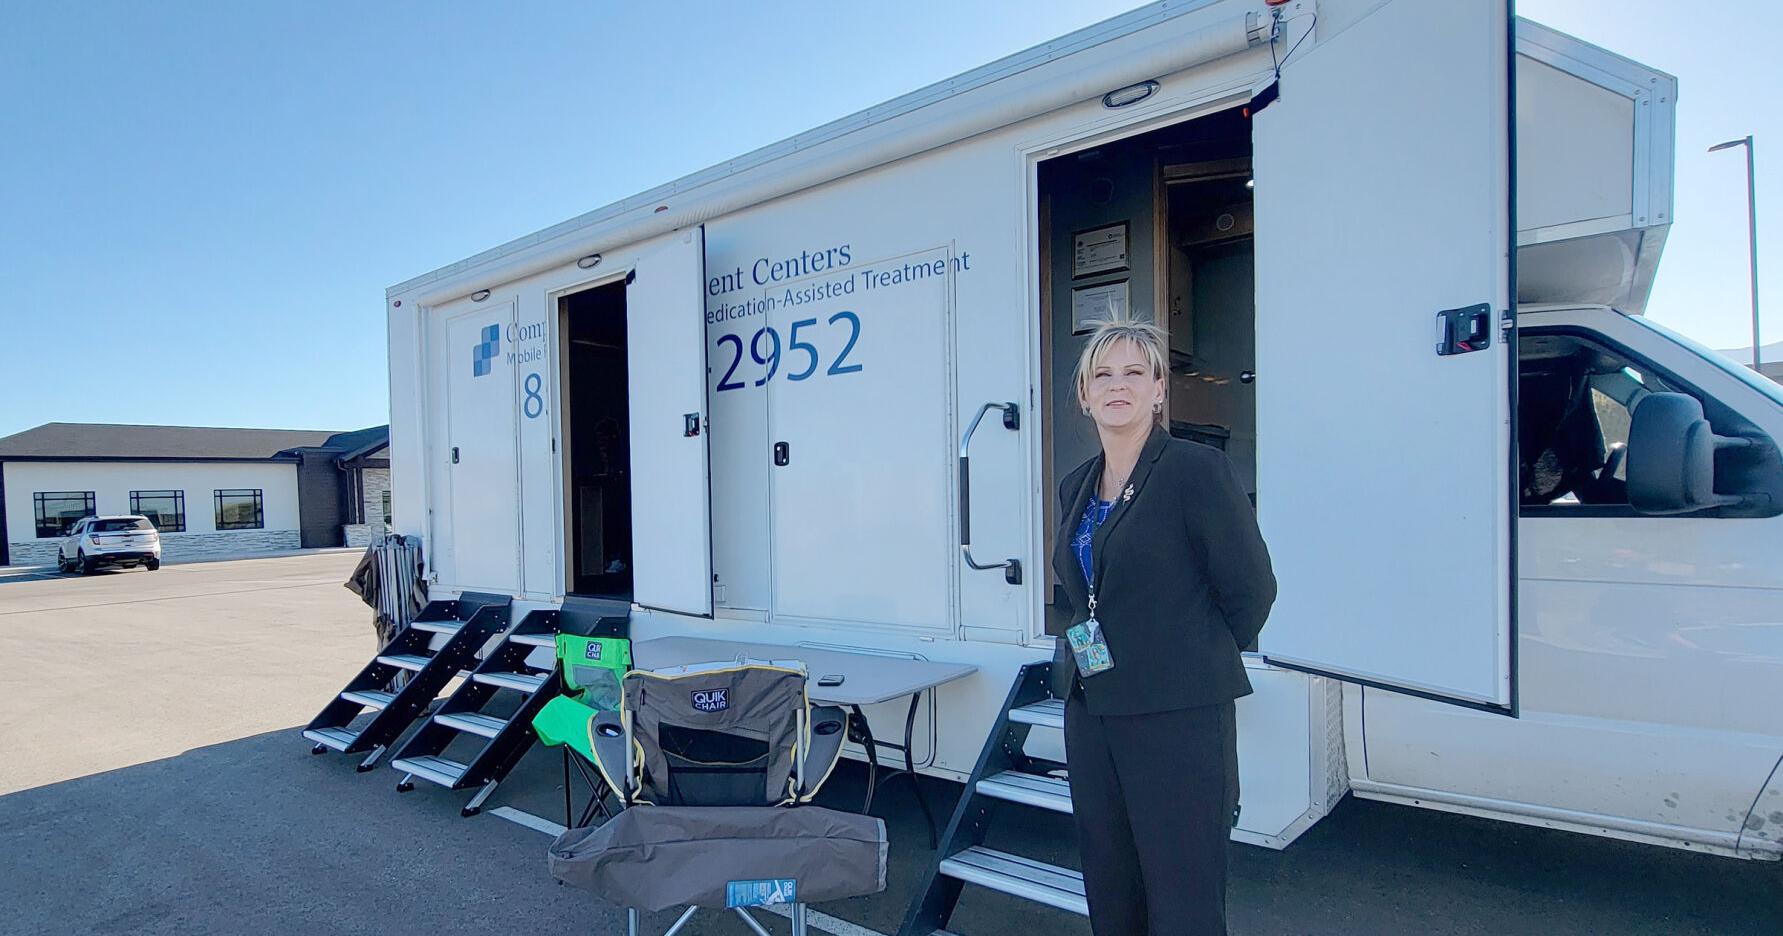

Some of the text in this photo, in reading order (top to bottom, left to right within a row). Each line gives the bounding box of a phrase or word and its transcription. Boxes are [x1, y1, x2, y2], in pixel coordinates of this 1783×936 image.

[752, 243, 851, 286] Centers
[861, 251, 971, 290] Treatment
[506, 347, 542, 366] Mobile
[716, 310, 863, 392] 2952
[524, 372, 543, 419] 8
[694, 691, 726, 704] QUIK
[695, 701, 726, 710] CHAIR
